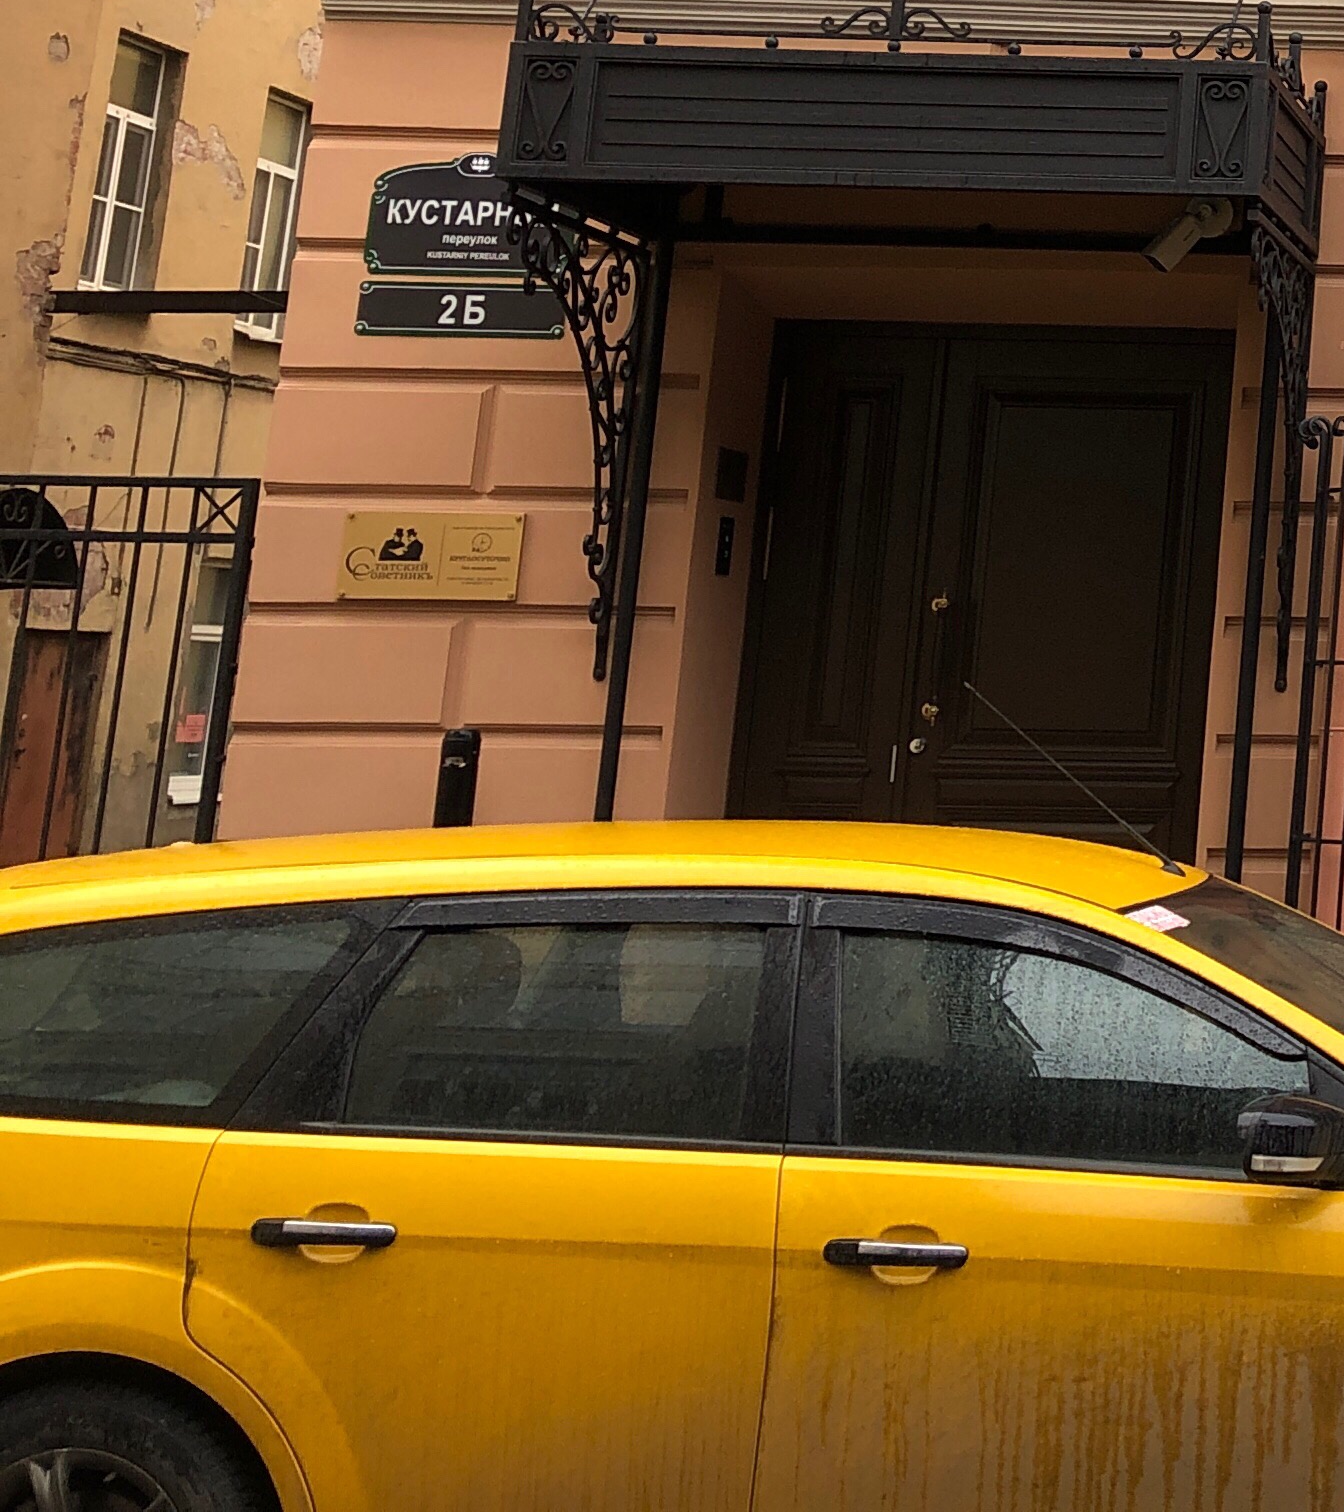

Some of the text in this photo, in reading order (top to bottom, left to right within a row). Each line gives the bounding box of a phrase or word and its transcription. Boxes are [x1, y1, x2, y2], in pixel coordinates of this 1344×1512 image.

[386, 198, 560, 229] КУСТАРН
[441, 233, 498, 247] переулок
[426, 250, 510, 261] KUSTARNIY PEREULOK
[437, 294, 487, 326] 2Б
[345, 546, 429, 576] Статский
[353, 563, 433, 581] Советникъ
